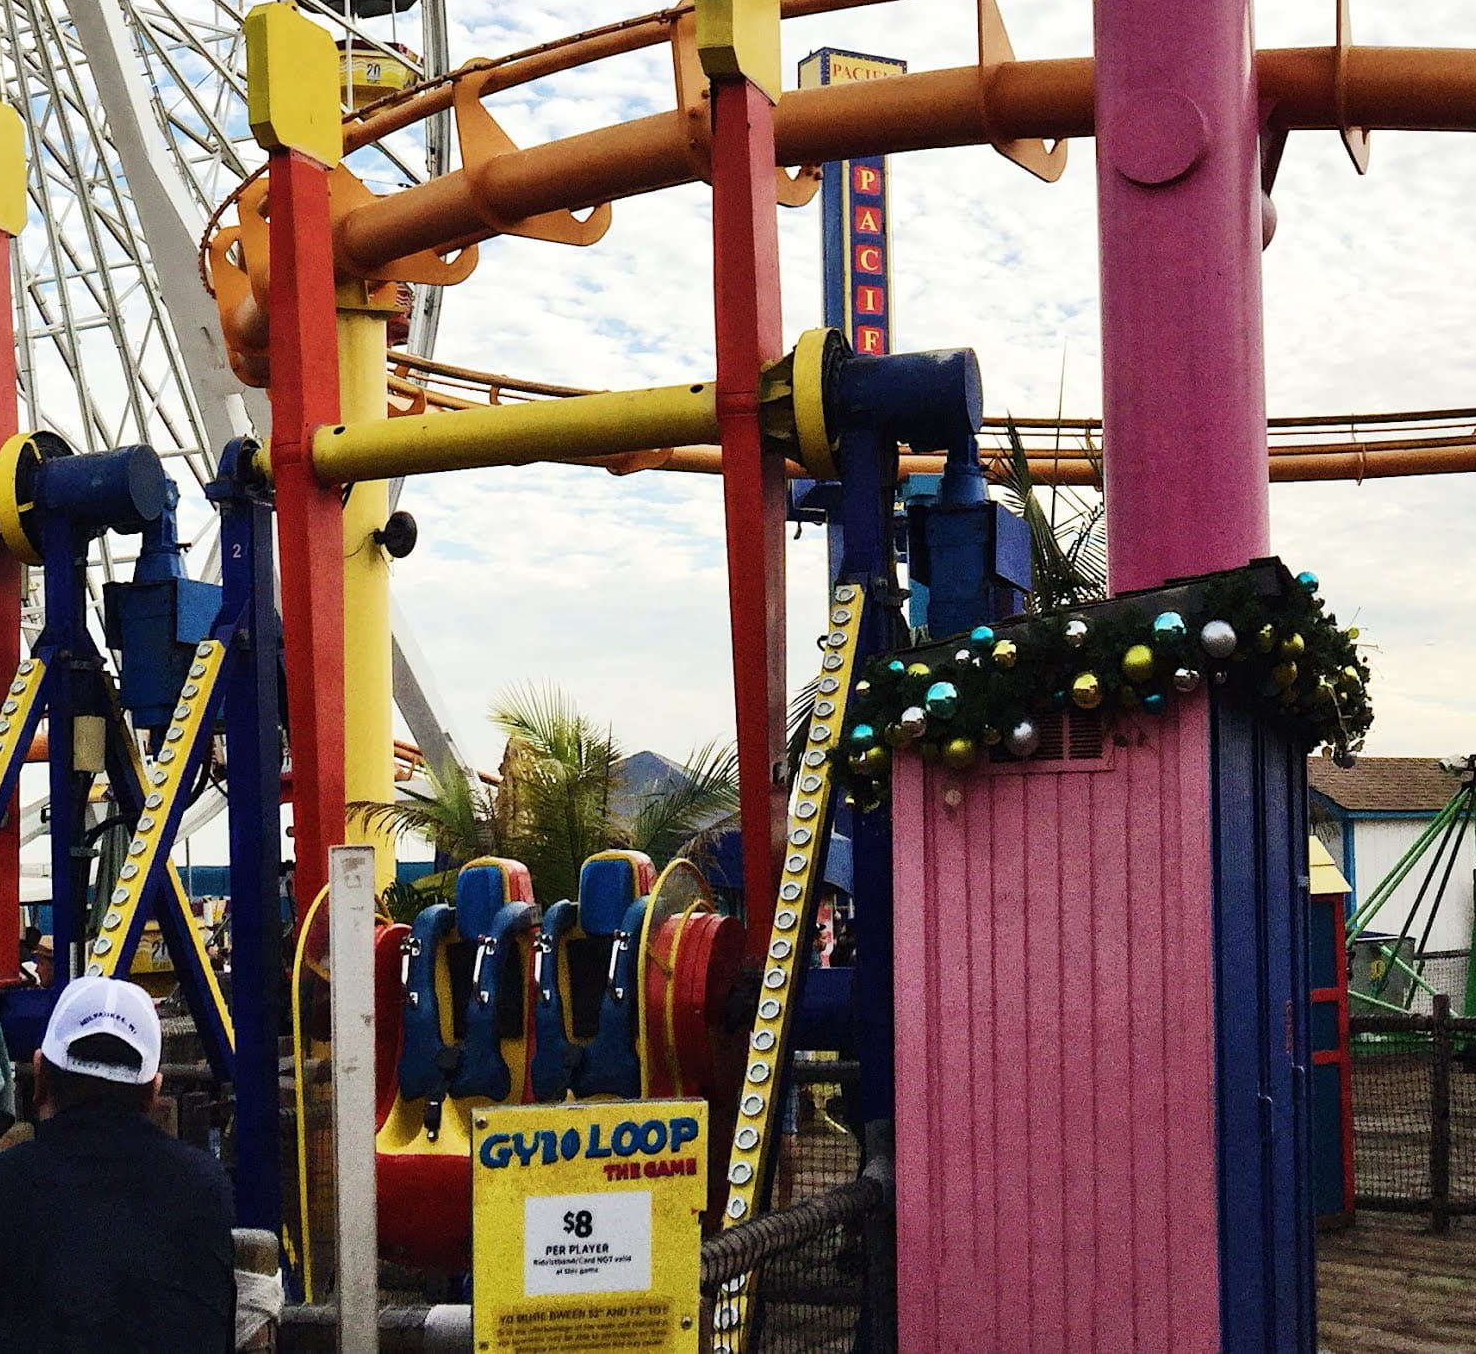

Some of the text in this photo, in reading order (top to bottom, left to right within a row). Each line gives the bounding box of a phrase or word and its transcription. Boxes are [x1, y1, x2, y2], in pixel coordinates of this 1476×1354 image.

[367, 63, 381, 79] 20
[232, 543, 242, 559] 2
[584, 1116, 699, 1160] LOOP
[603, 1157, 697, 1182] THE GAME
[562, 1209, 594, 1238] $8
[545, 1243, 609, 1256] PER PLAYER
